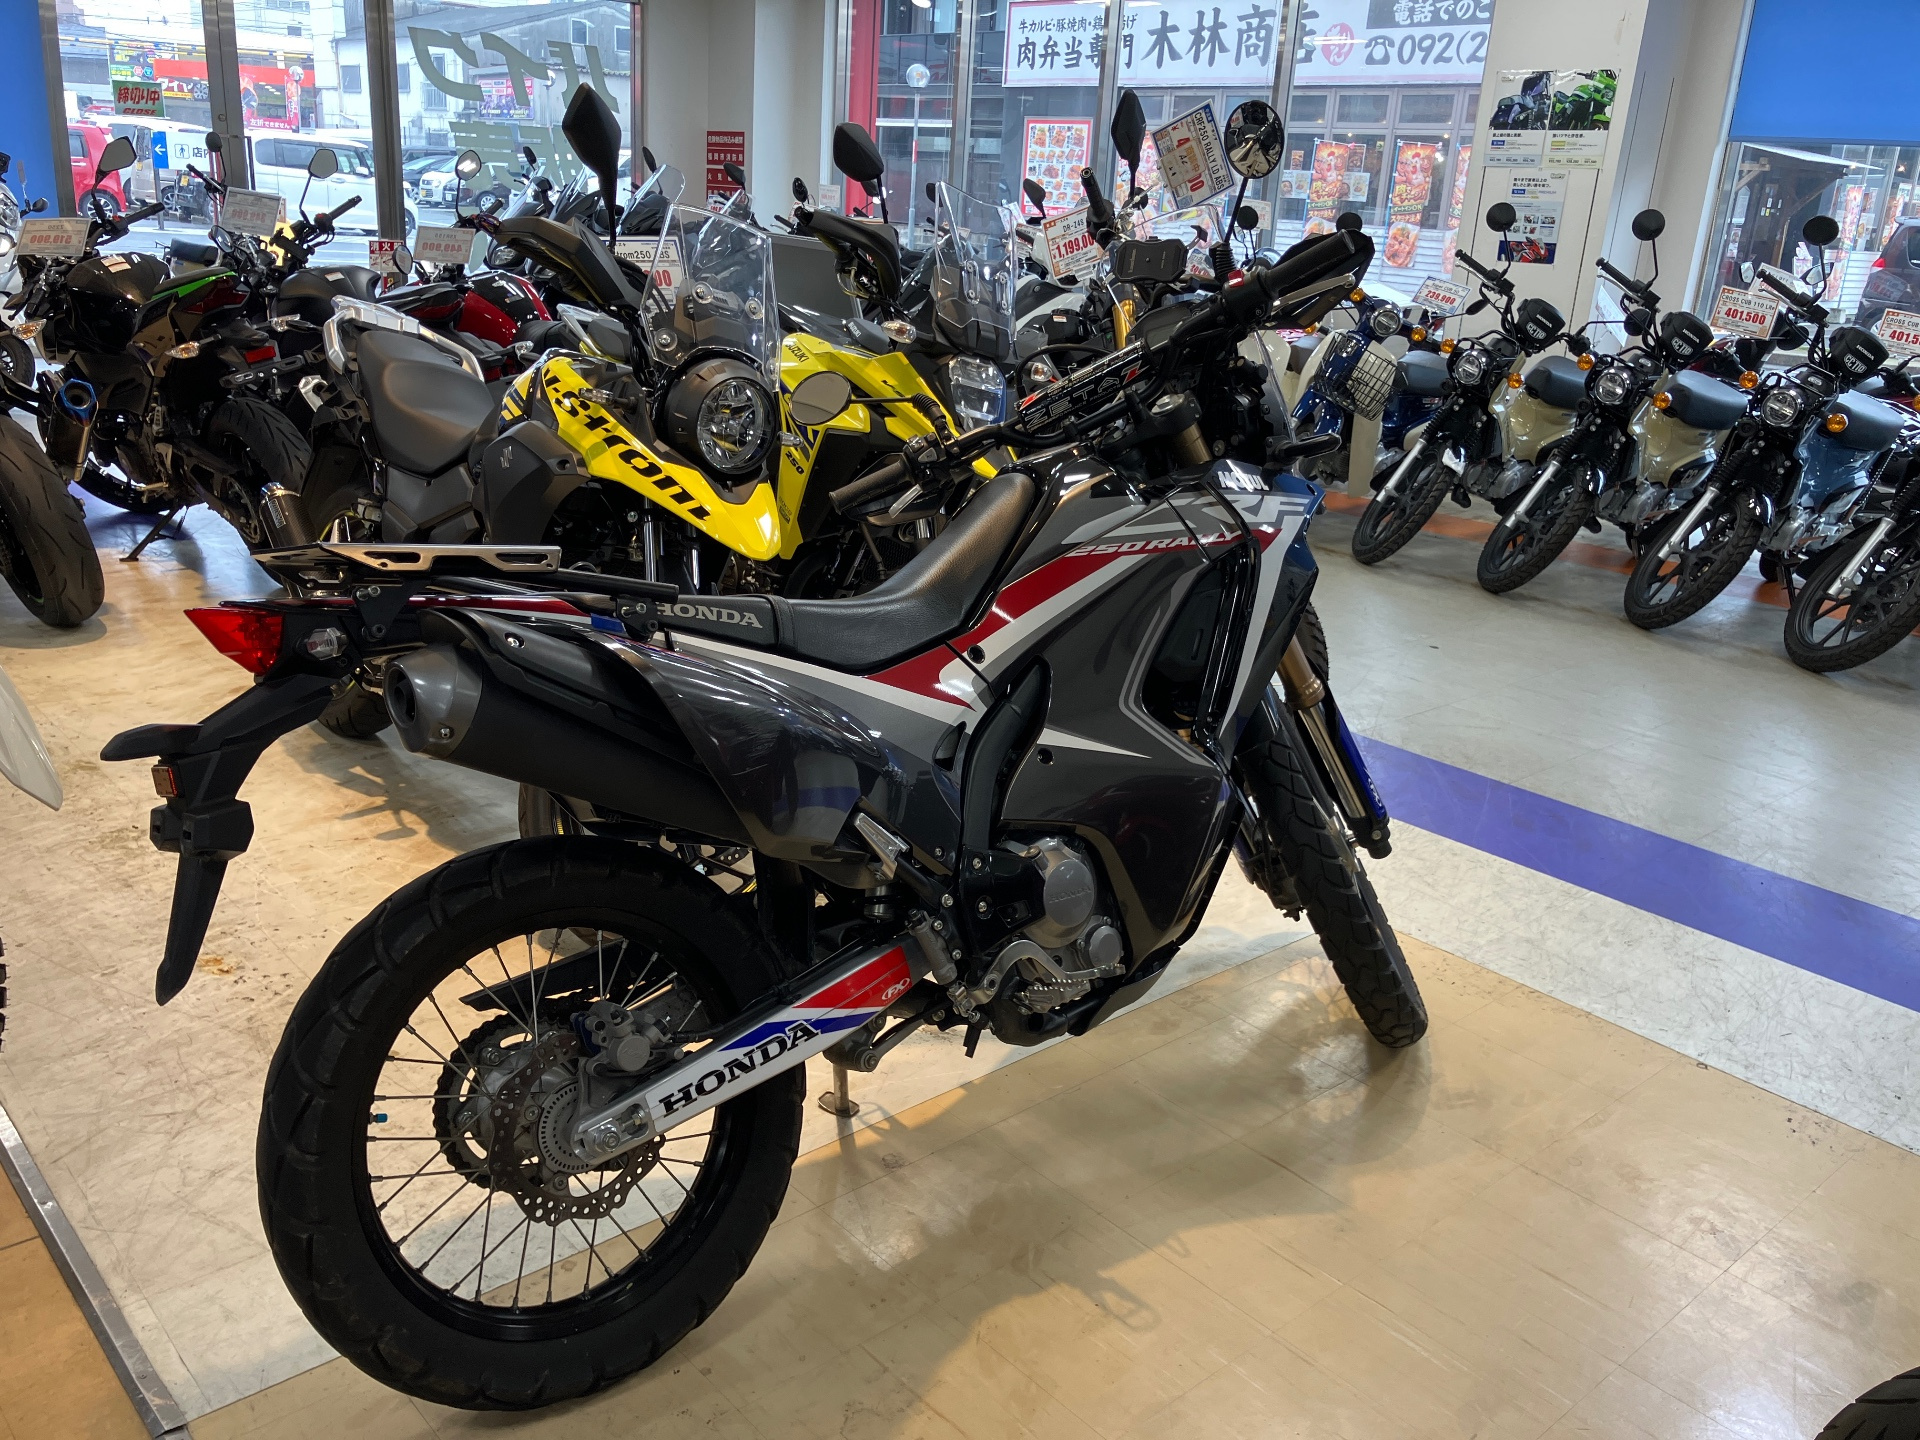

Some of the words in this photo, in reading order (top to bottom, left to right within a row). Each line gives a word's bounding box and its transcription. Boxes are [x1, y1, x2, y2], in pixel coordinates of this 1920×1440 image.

[122, 107, 157, 115] CLOSE
[1194, 112, 1209, 142] CRF250
[1203, 142, 1217, 164] RALLY
[1214, 176, 1223, 190] ABS
[1056, 232, 1095, 259] 1,199,00
[1425, 290, 1456, 305] 239,900
[1722, 294, 1740, 303] CROSS
[1536, 313, 1552, 328] HONDA
[1725, 307, 1767, 325] 401,500
[1886, 316, 1906, 325] CROSS
[1907, 320, 1920, 328] CUB
[847, 321, 861, 338] SUZUKI
[1682, 328, 1700, 344] HONDA
[1888, 329, 1920, 345] 401,5
[785, 341, 810, 363] SUZUKI
[1856, 344, 1875, 361] HONDA
[1024, 377, 1120, 429] ZETA
[785, 451, 805, 475] 250
[1217, 470, 1269, 492] MOTUL
[1067, 540, 1143, 557] 250
[1149, 530, 1242, 550] RALLY
[656, 601, 763, 629] HONDA
[658, 1020, 821, 1118] HONDA
